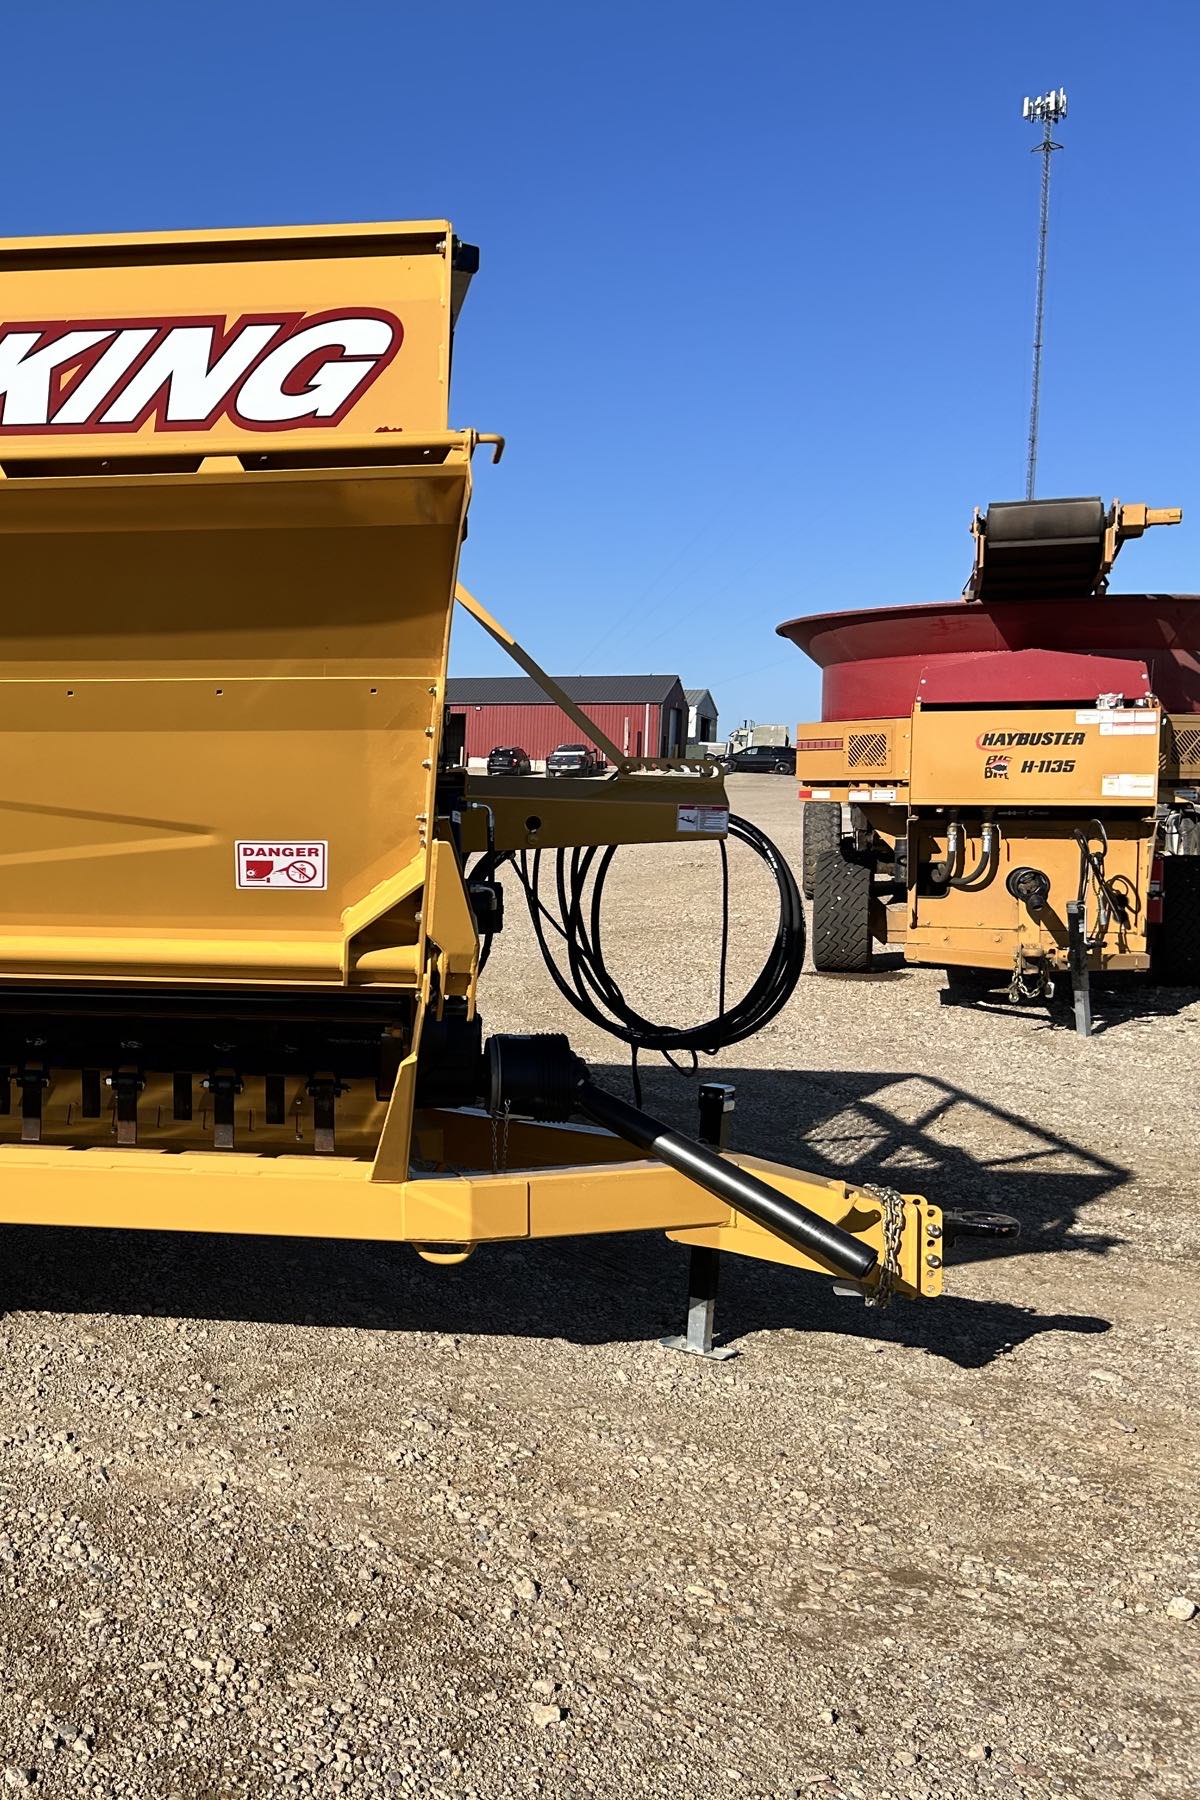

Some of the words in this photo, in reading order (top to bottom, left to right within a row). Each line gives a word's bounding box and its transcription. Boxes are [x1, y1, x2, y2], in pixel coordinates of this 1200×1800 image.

[981, 732, 1086, 746] HAYBUSTER
[1020, 760, 1076, 773] H-1135
[242, 847, 320, 857] DANGER
